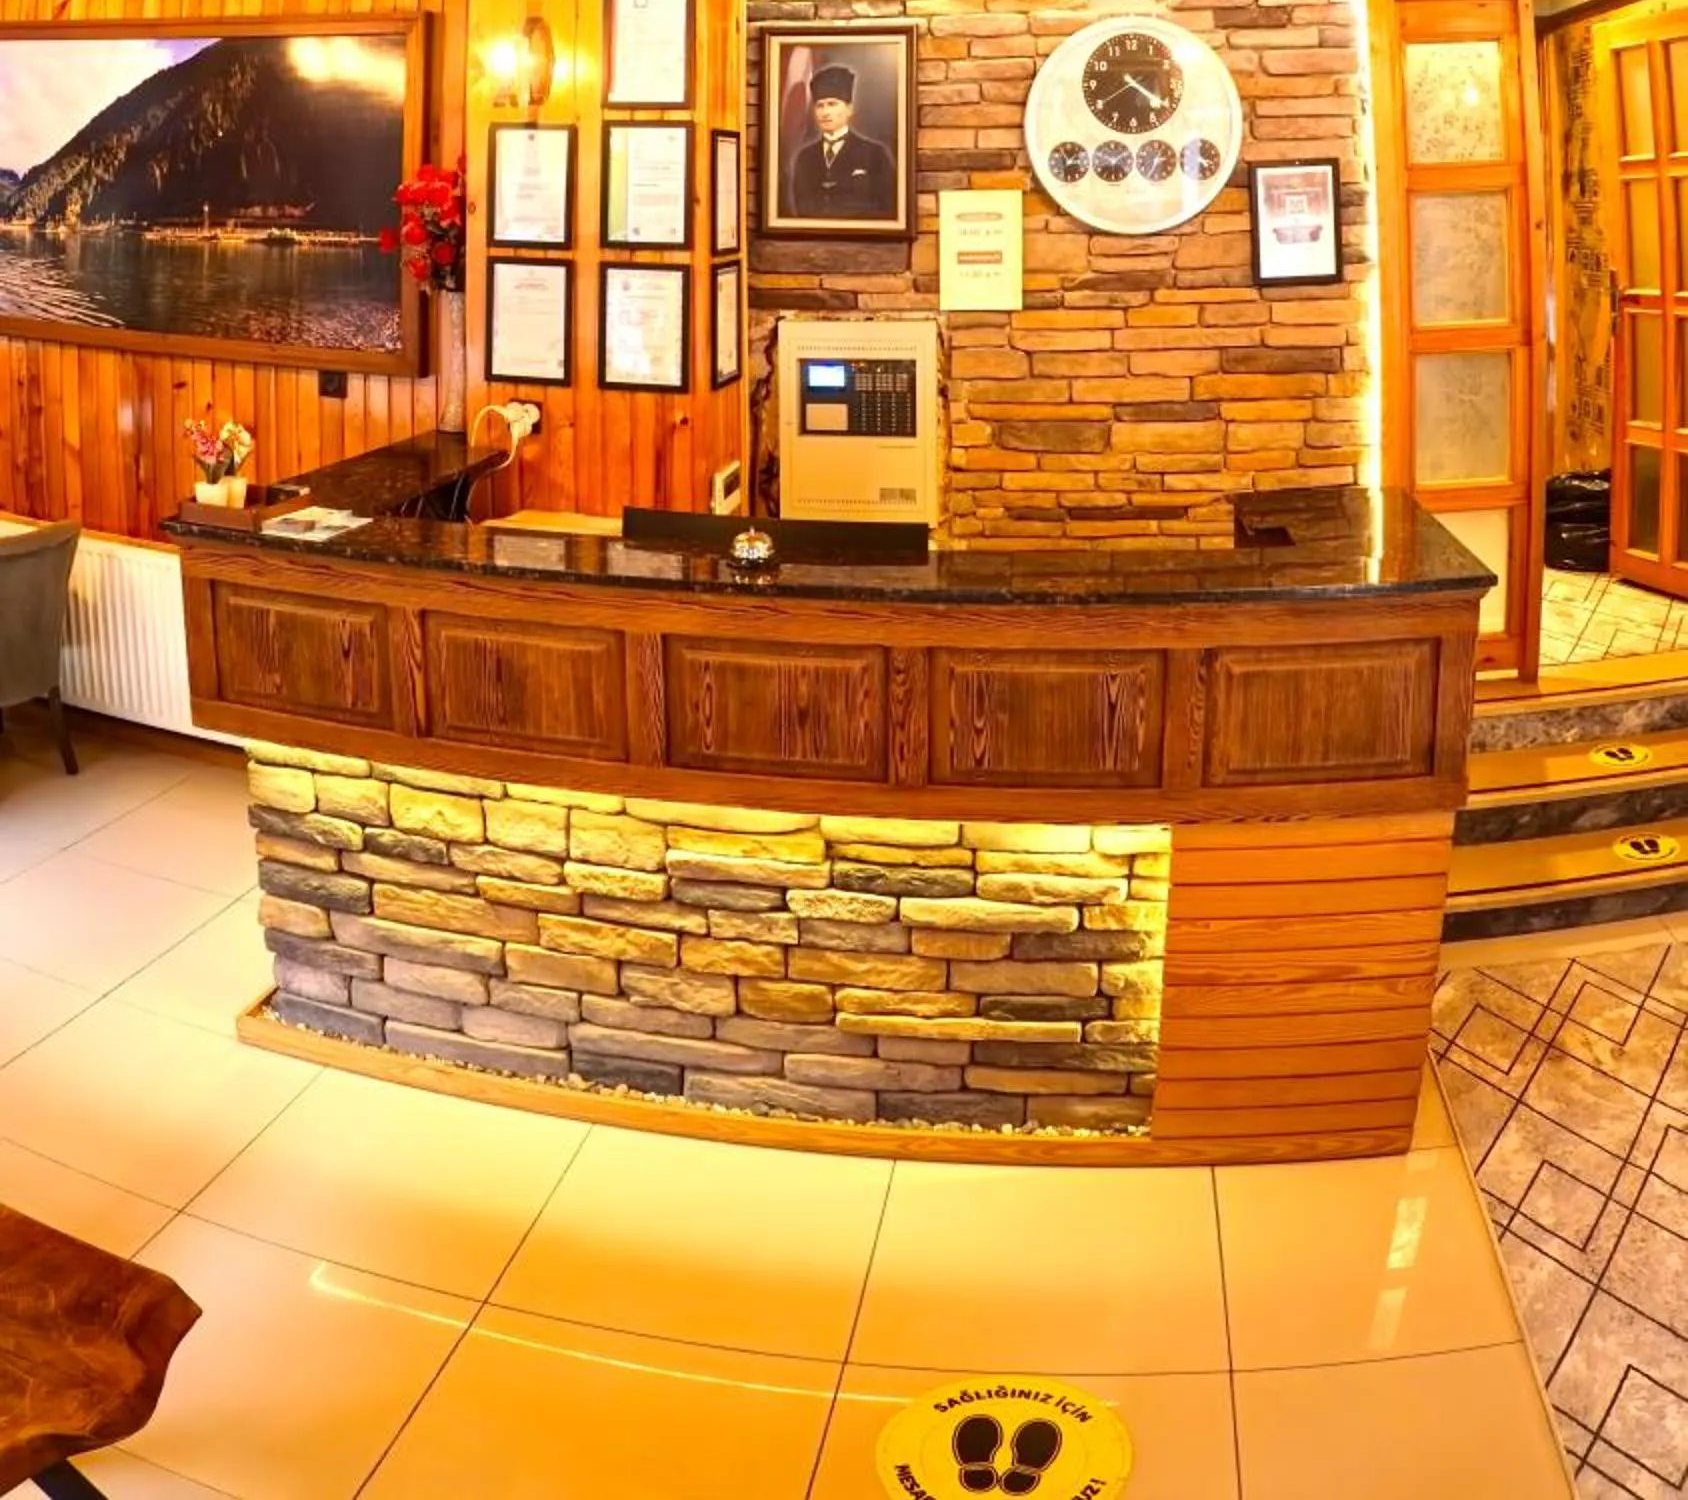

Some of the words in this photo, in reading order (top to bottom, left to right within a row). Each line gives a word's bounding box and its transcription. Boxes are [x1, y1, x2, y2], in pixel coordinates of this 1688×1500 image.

[1125, 39, 1138, 51] 12
[1148, 45, 1154, 56] 1
[1108, 45, 1120, 57] 11
[1093, 61, 1108, 71] 10
[1089, 79, 1097, 90] 9
[1112, 112, 1119, 122] 7
[1129, 117, 1138, 127] 6
[933, 1384, 1053, 1413] SAĞLIĞINIZ
[1055, 1396, 1093, 1423] İÇİN
